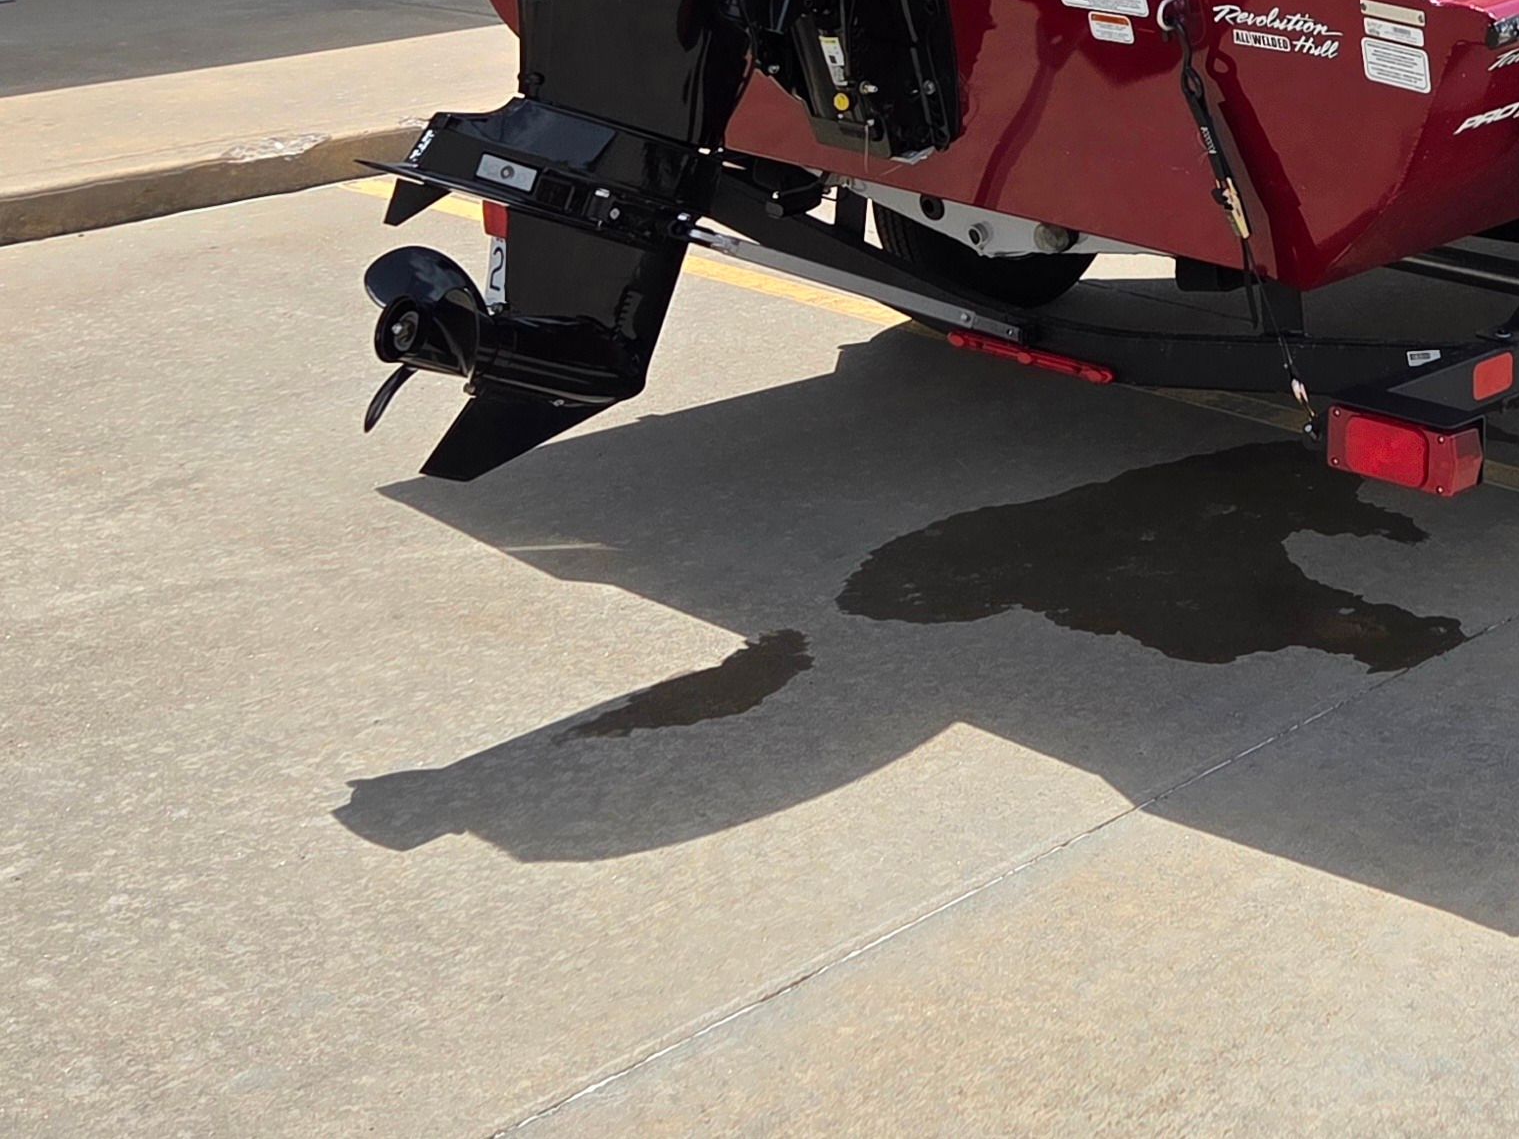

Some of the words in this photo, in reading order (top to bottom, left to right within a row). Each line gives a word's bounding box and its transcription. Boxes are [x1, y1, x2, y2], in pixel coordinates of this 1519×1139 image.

[1212, 4, 1343, 36] Revolution
[1235, 30, 1251, 45] ALL
[1252, 33, 1289, 50] WELDED
[1292, 35, 1340, 59] Hull
